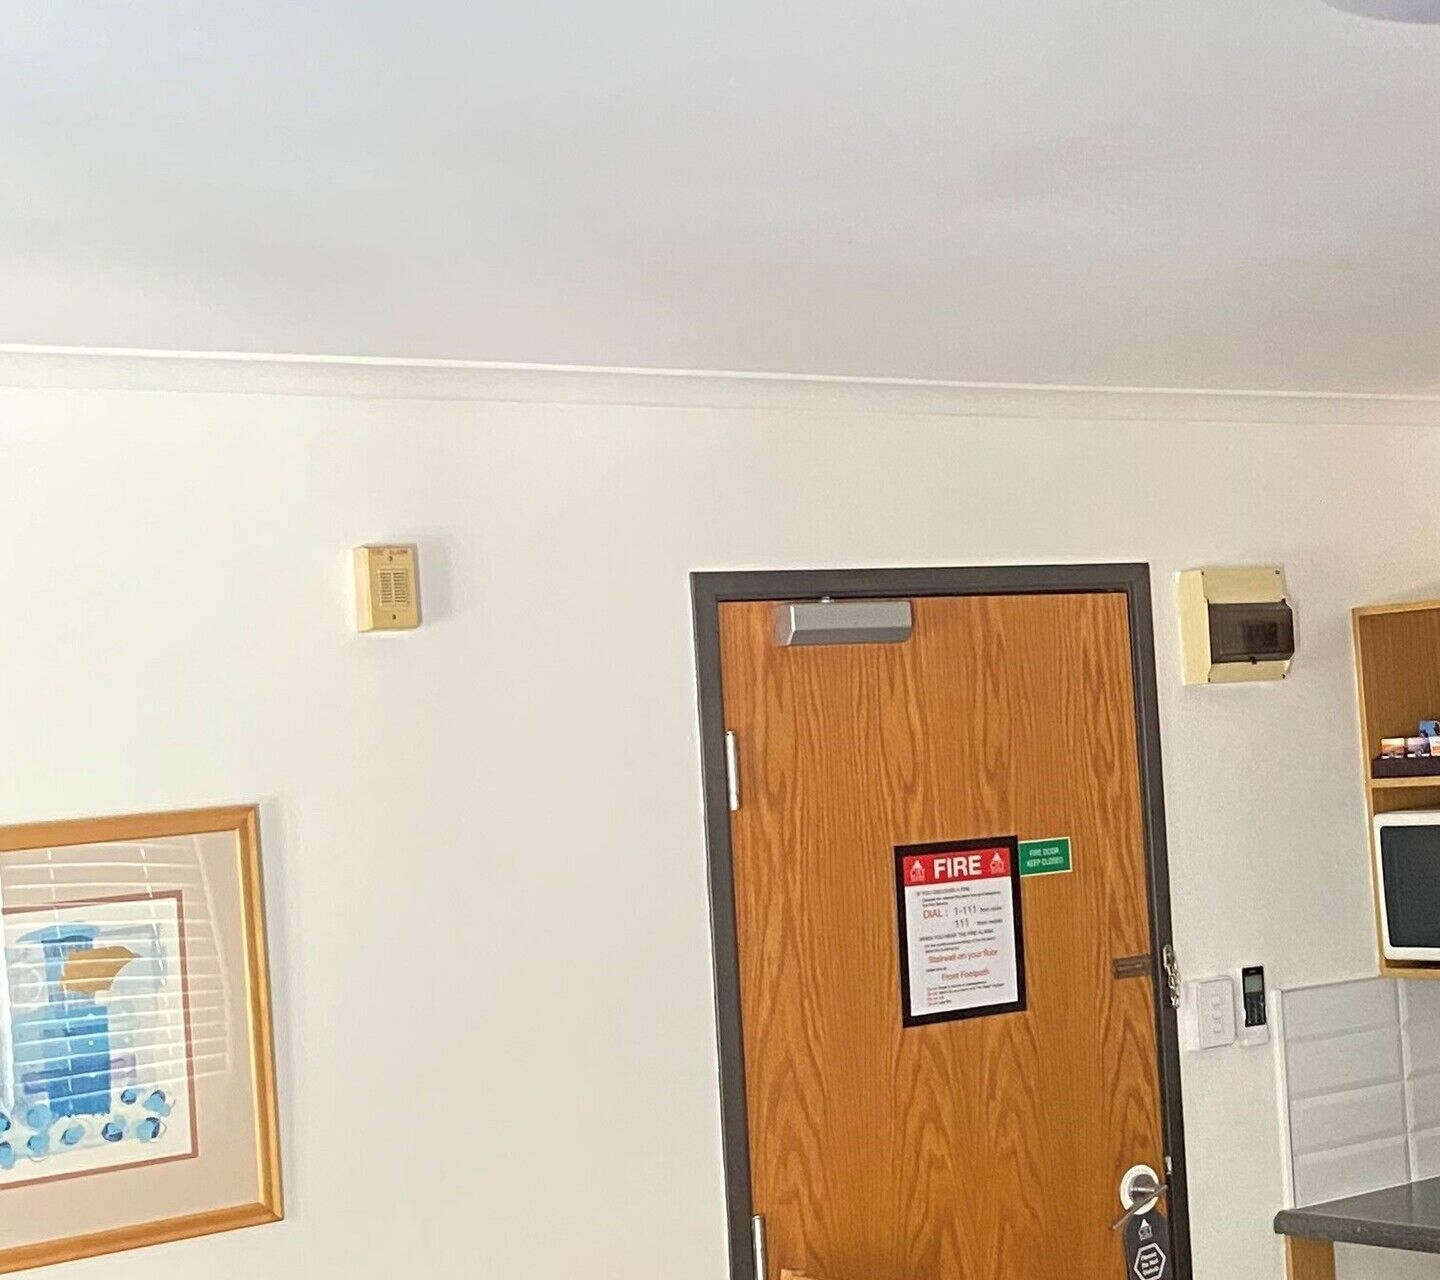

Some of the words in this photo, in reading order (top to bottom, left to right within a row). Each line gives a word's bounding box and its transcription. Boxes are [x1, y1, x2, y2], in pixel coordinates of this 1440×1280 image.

[1043, 846, 1059, 856] DOOR
[933, 855, 982, 879] FIRE
[923, 908, 943, 919] DIAL
[954, 905, 976, 916] 1-111
[955, 918, 969, 928] 111
[967, 951, 981, 960] your
